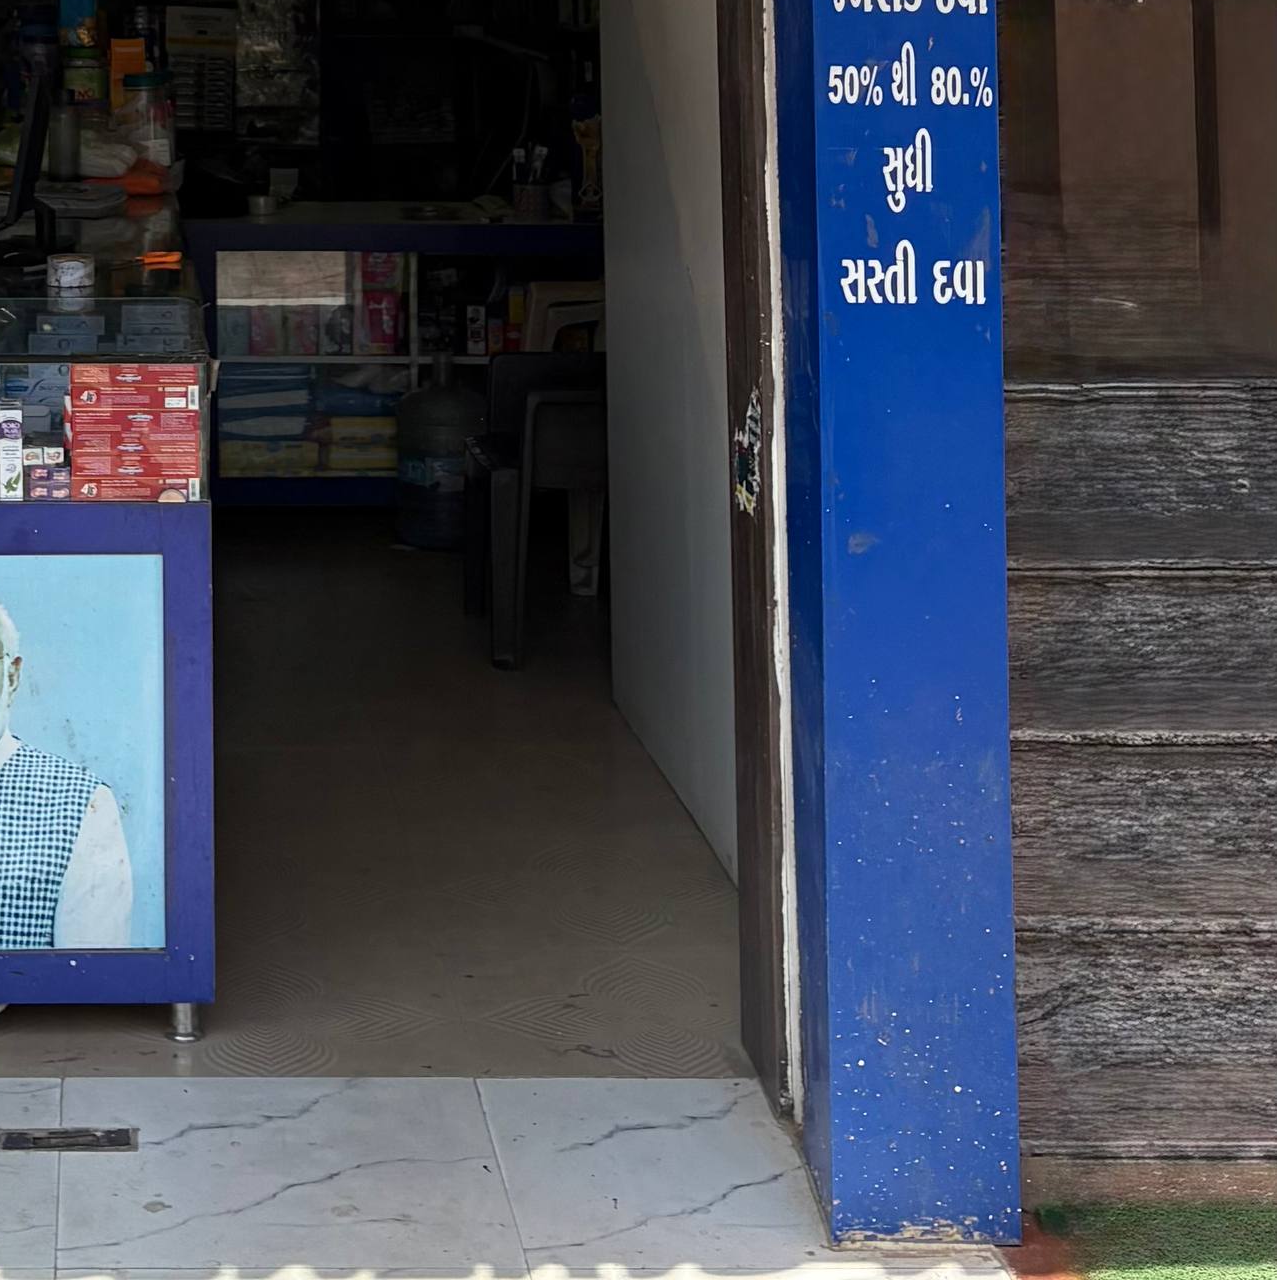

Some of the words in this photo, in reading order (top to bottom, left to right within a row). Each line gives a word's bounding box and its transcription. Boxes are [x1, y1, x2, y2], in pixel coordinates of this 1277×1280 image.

[828, 65, 884, 107] 50%
[891, 40, 917, 107] થી
[931, 66, 993, 108] 80.%
[882, 127, 933, 213] સુધી
[840, 239, 918, 305] સસ્તી
[933, 259, 987, 305] દવા
